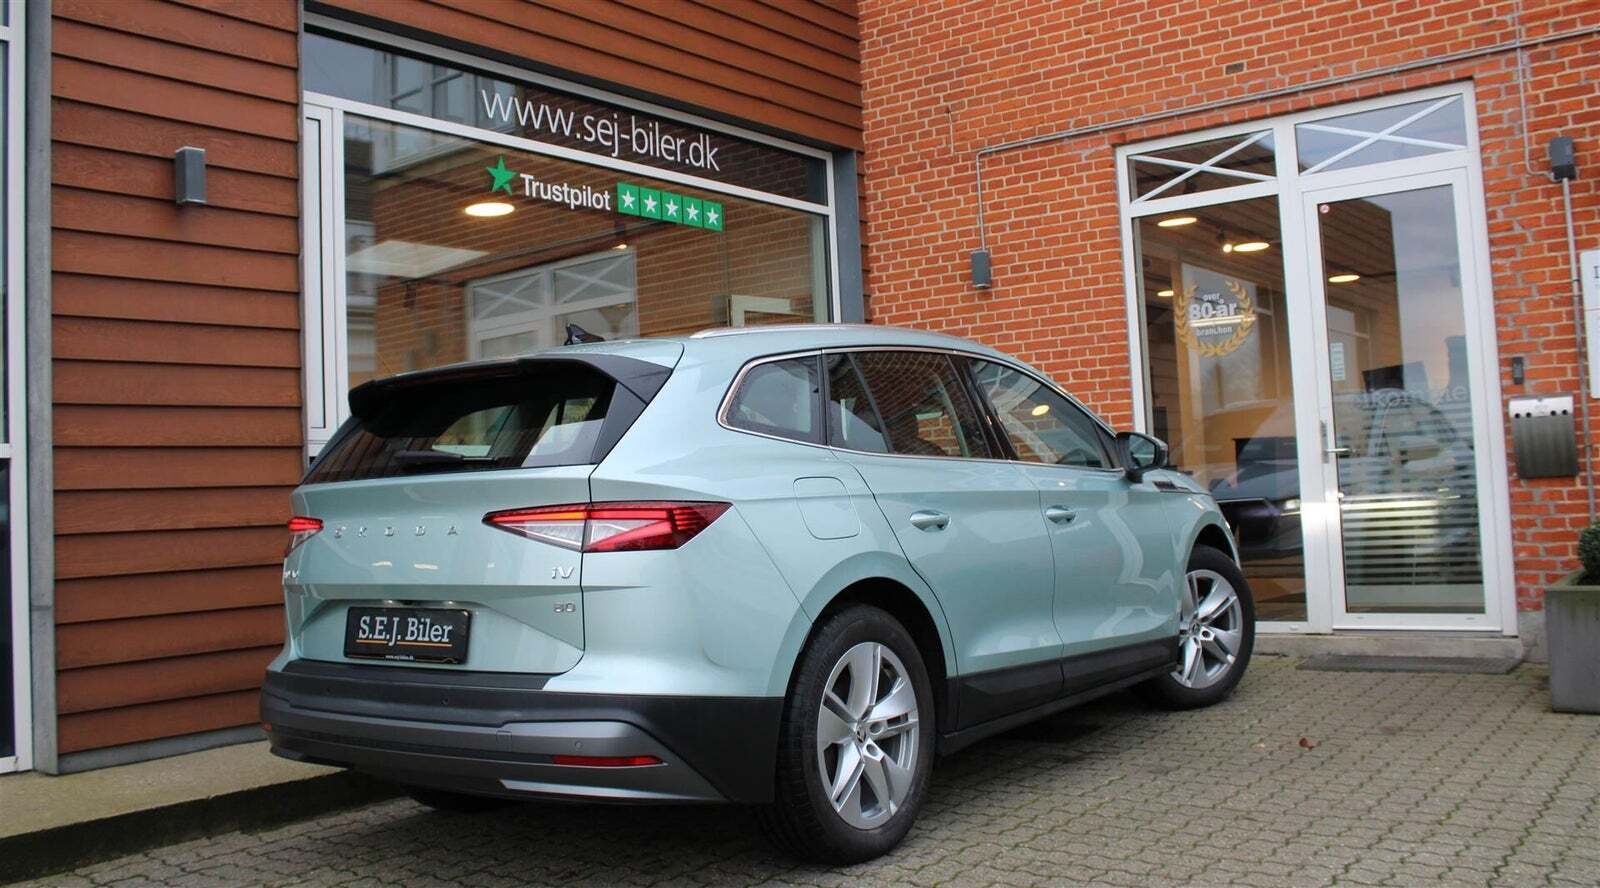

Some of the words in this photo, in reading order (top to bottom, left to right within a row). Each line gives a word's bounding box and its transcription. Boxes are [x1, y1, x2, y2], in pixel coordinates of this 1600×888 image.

[481, 89, 721, 172] www.sej-biler.dk
[519, 173, 612, 211] Trustpilot
[1203, 292, 1221, 301] over
[1189, 302, 1214, 320] 80
[553, 602, 577, 614] 80
[358, 615, 402, 647] S.E.J.
[404, 617, 453, 643] Biler
